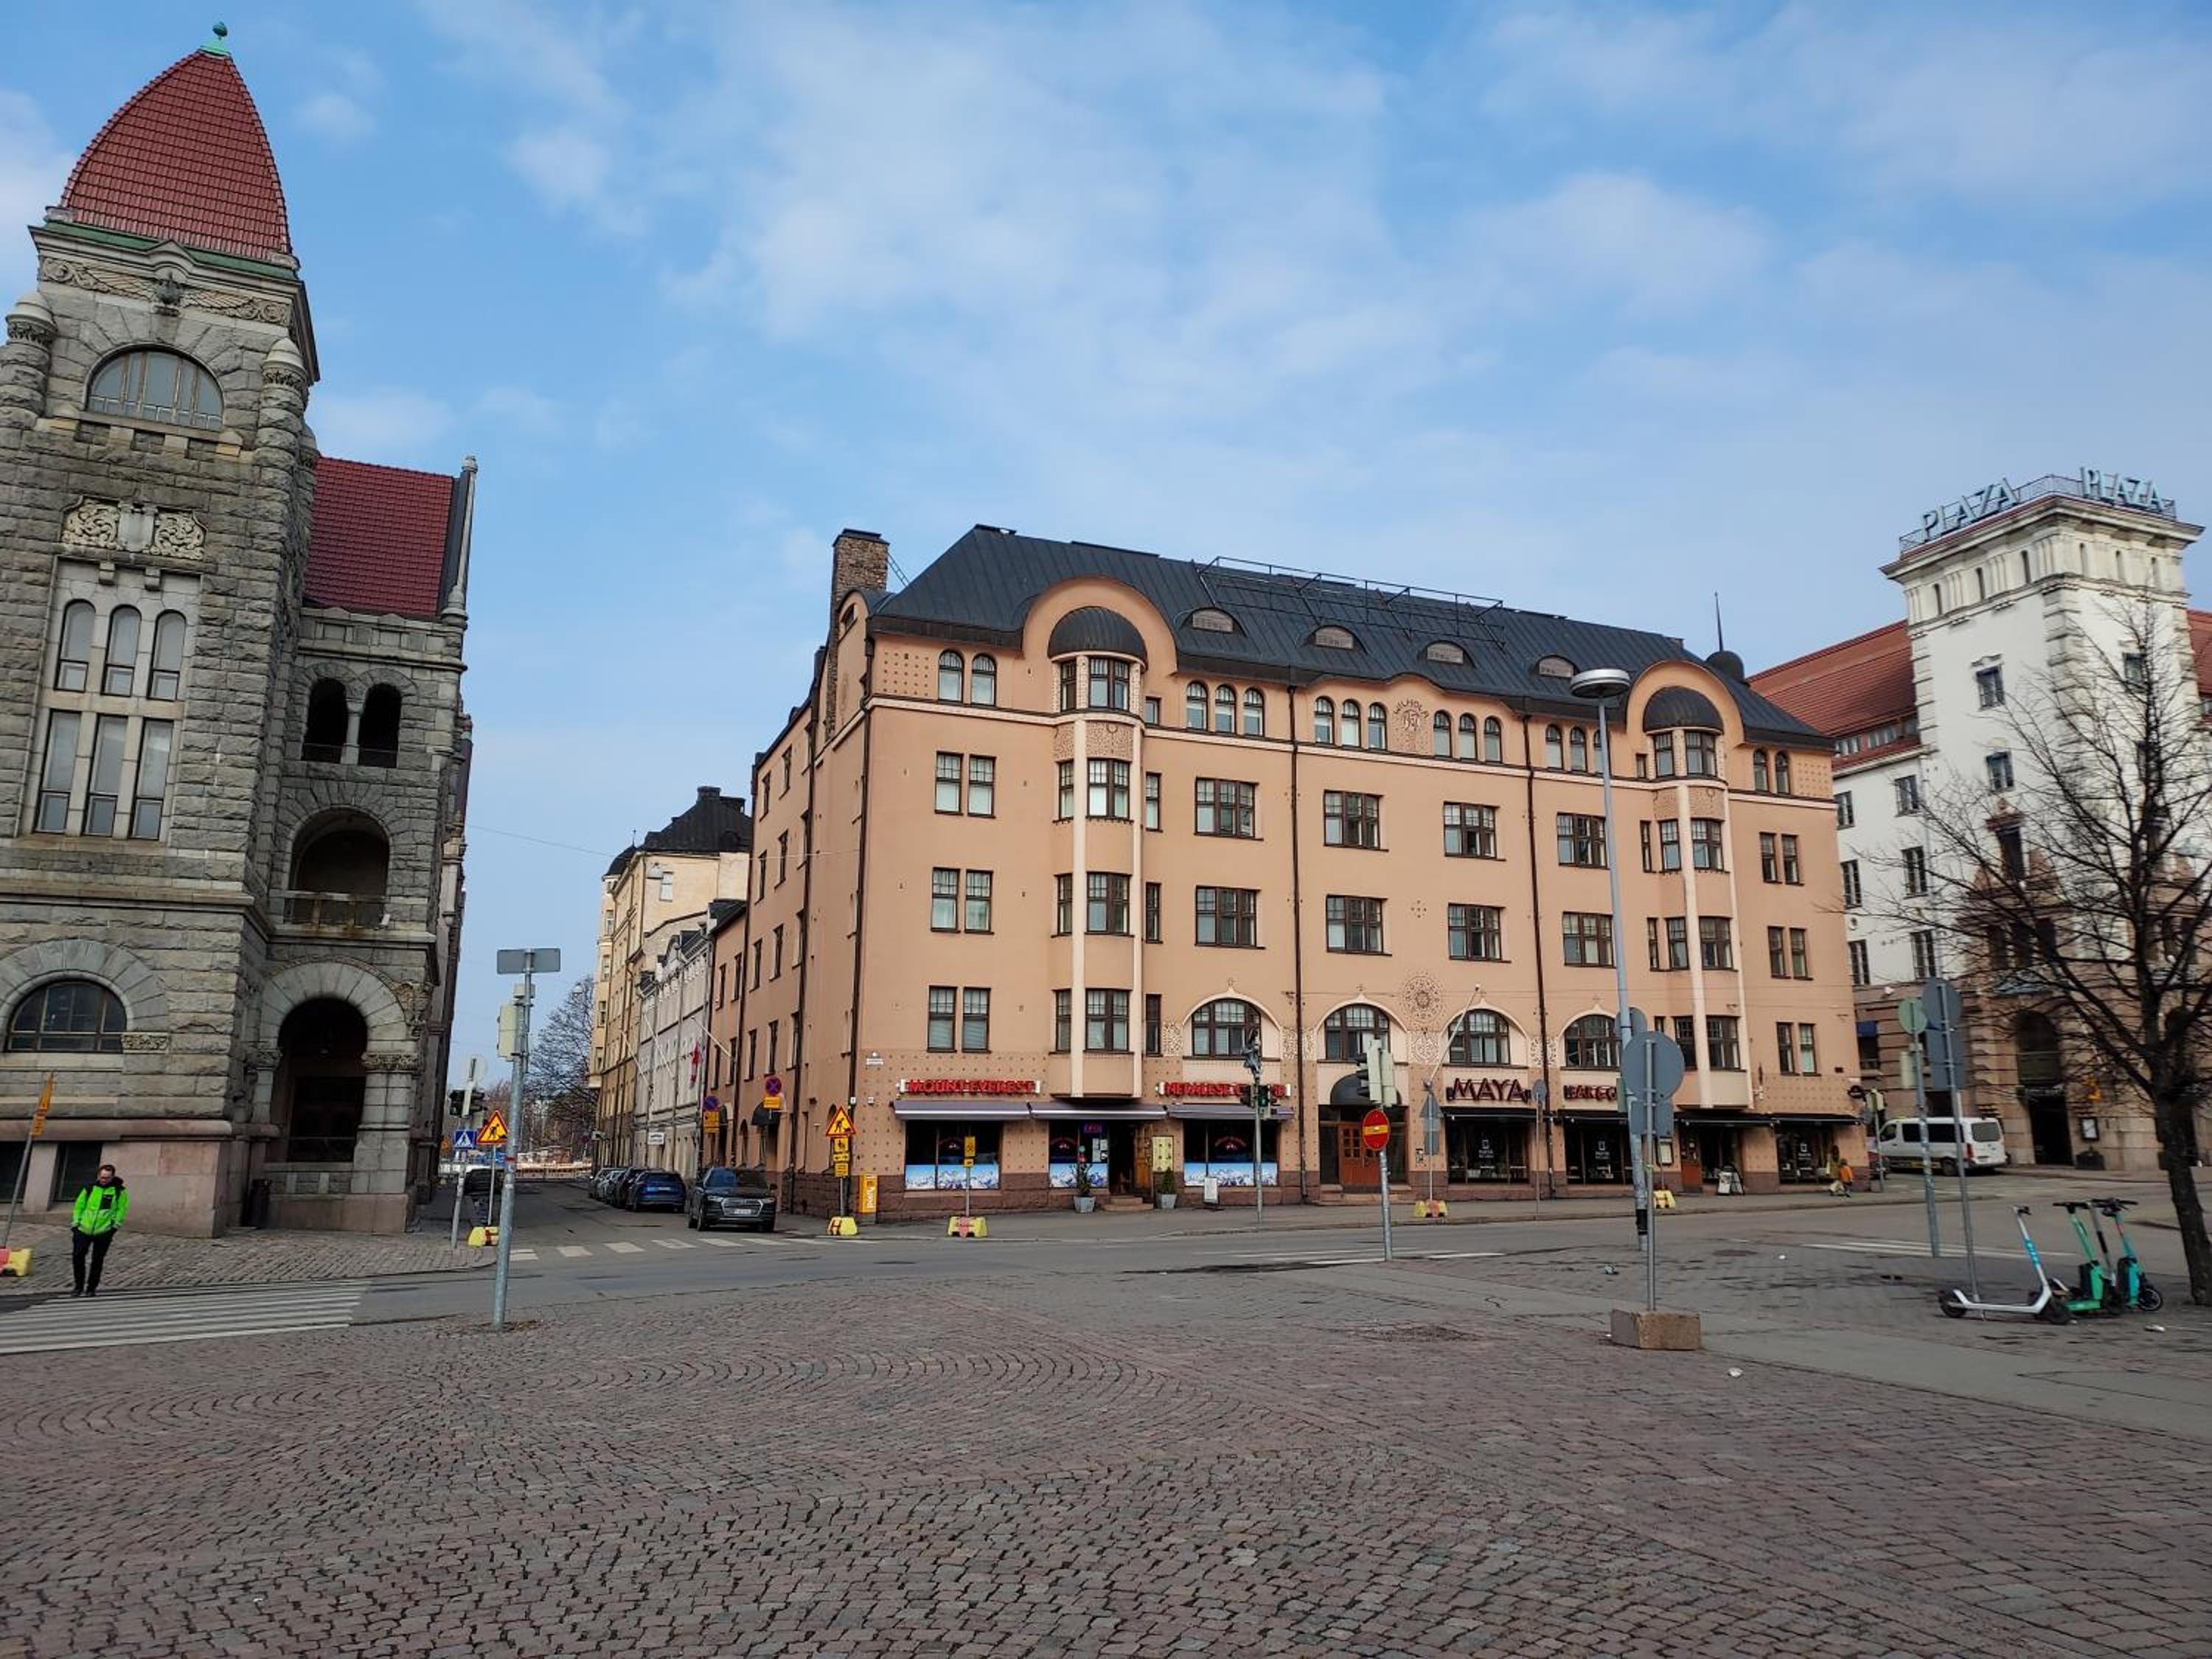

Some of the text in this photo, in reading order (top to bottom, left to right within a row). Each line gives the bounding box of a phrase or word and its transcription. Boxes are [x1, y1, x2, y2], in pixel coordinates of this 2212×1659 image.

[2080, 467, 2163, 512] PLAZA
[1921, 477, 2019, 542] PLAZA
[909, 1080, 1034, 1094] MOUNT EVEREST
[1453, 1077, 1528, 1103] MAYA
